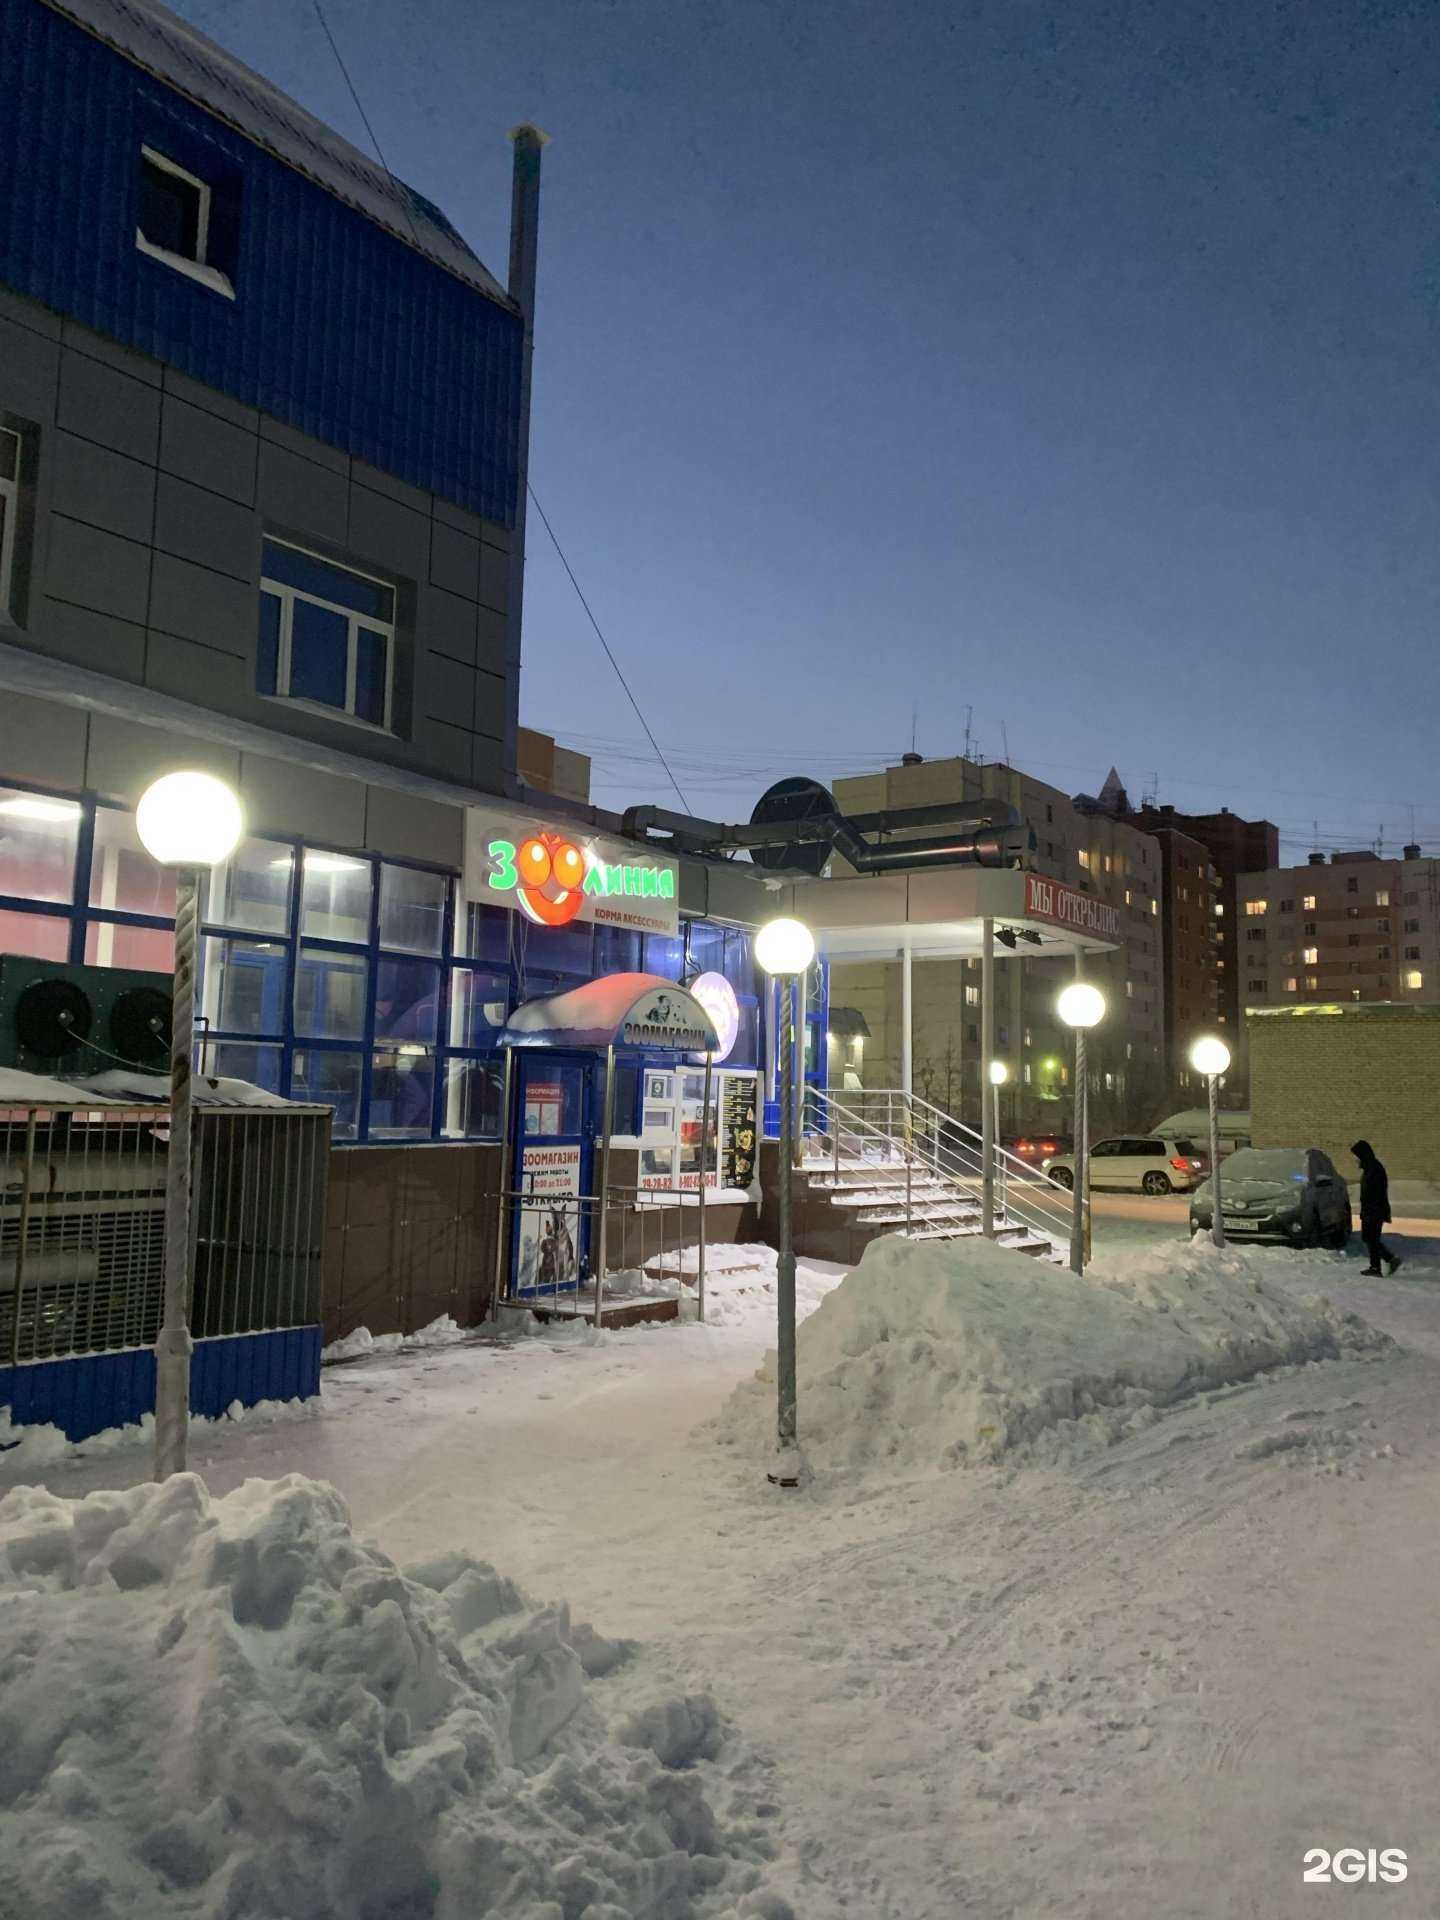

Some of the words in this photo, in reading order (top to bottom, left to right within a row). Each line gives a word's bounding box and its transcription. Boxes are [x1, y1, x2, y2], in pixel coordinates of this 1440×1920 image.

[1029, 879, 1054, 915] МЫ
[595, 907, 622, 922] КОРМА
[624, 1022, 705, 1050] ЗООМАГАЗИН
[523, 1151, 579, 1167] ЗООМАГАЗИН
